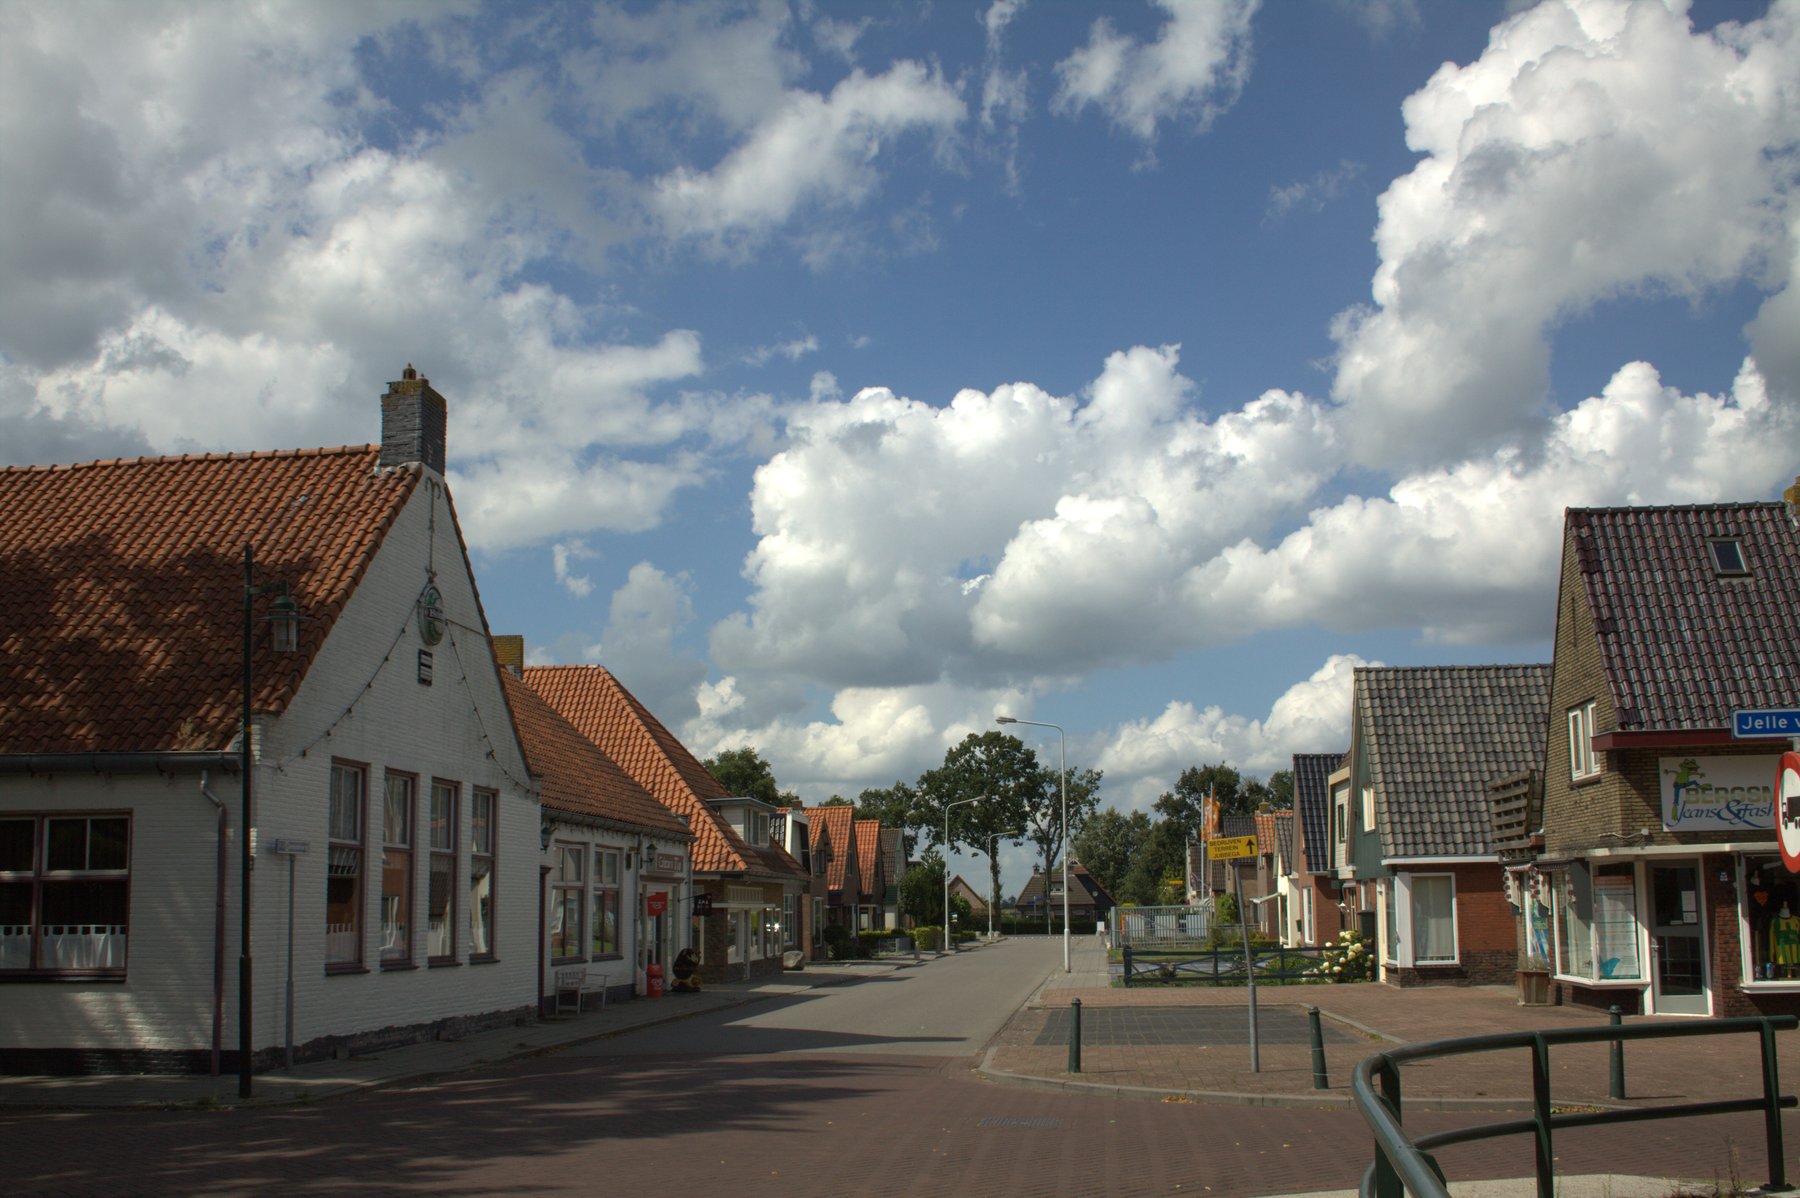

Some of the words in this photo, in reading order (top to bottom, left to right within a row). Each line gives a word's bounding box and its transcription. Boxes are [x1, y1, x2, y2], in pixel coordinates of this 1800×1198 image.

[1742, 715, 1788, 730] Jelle
[1685, 785, 1775, 804] BERGSM
[1741, 801, 1776, 818] Fash
